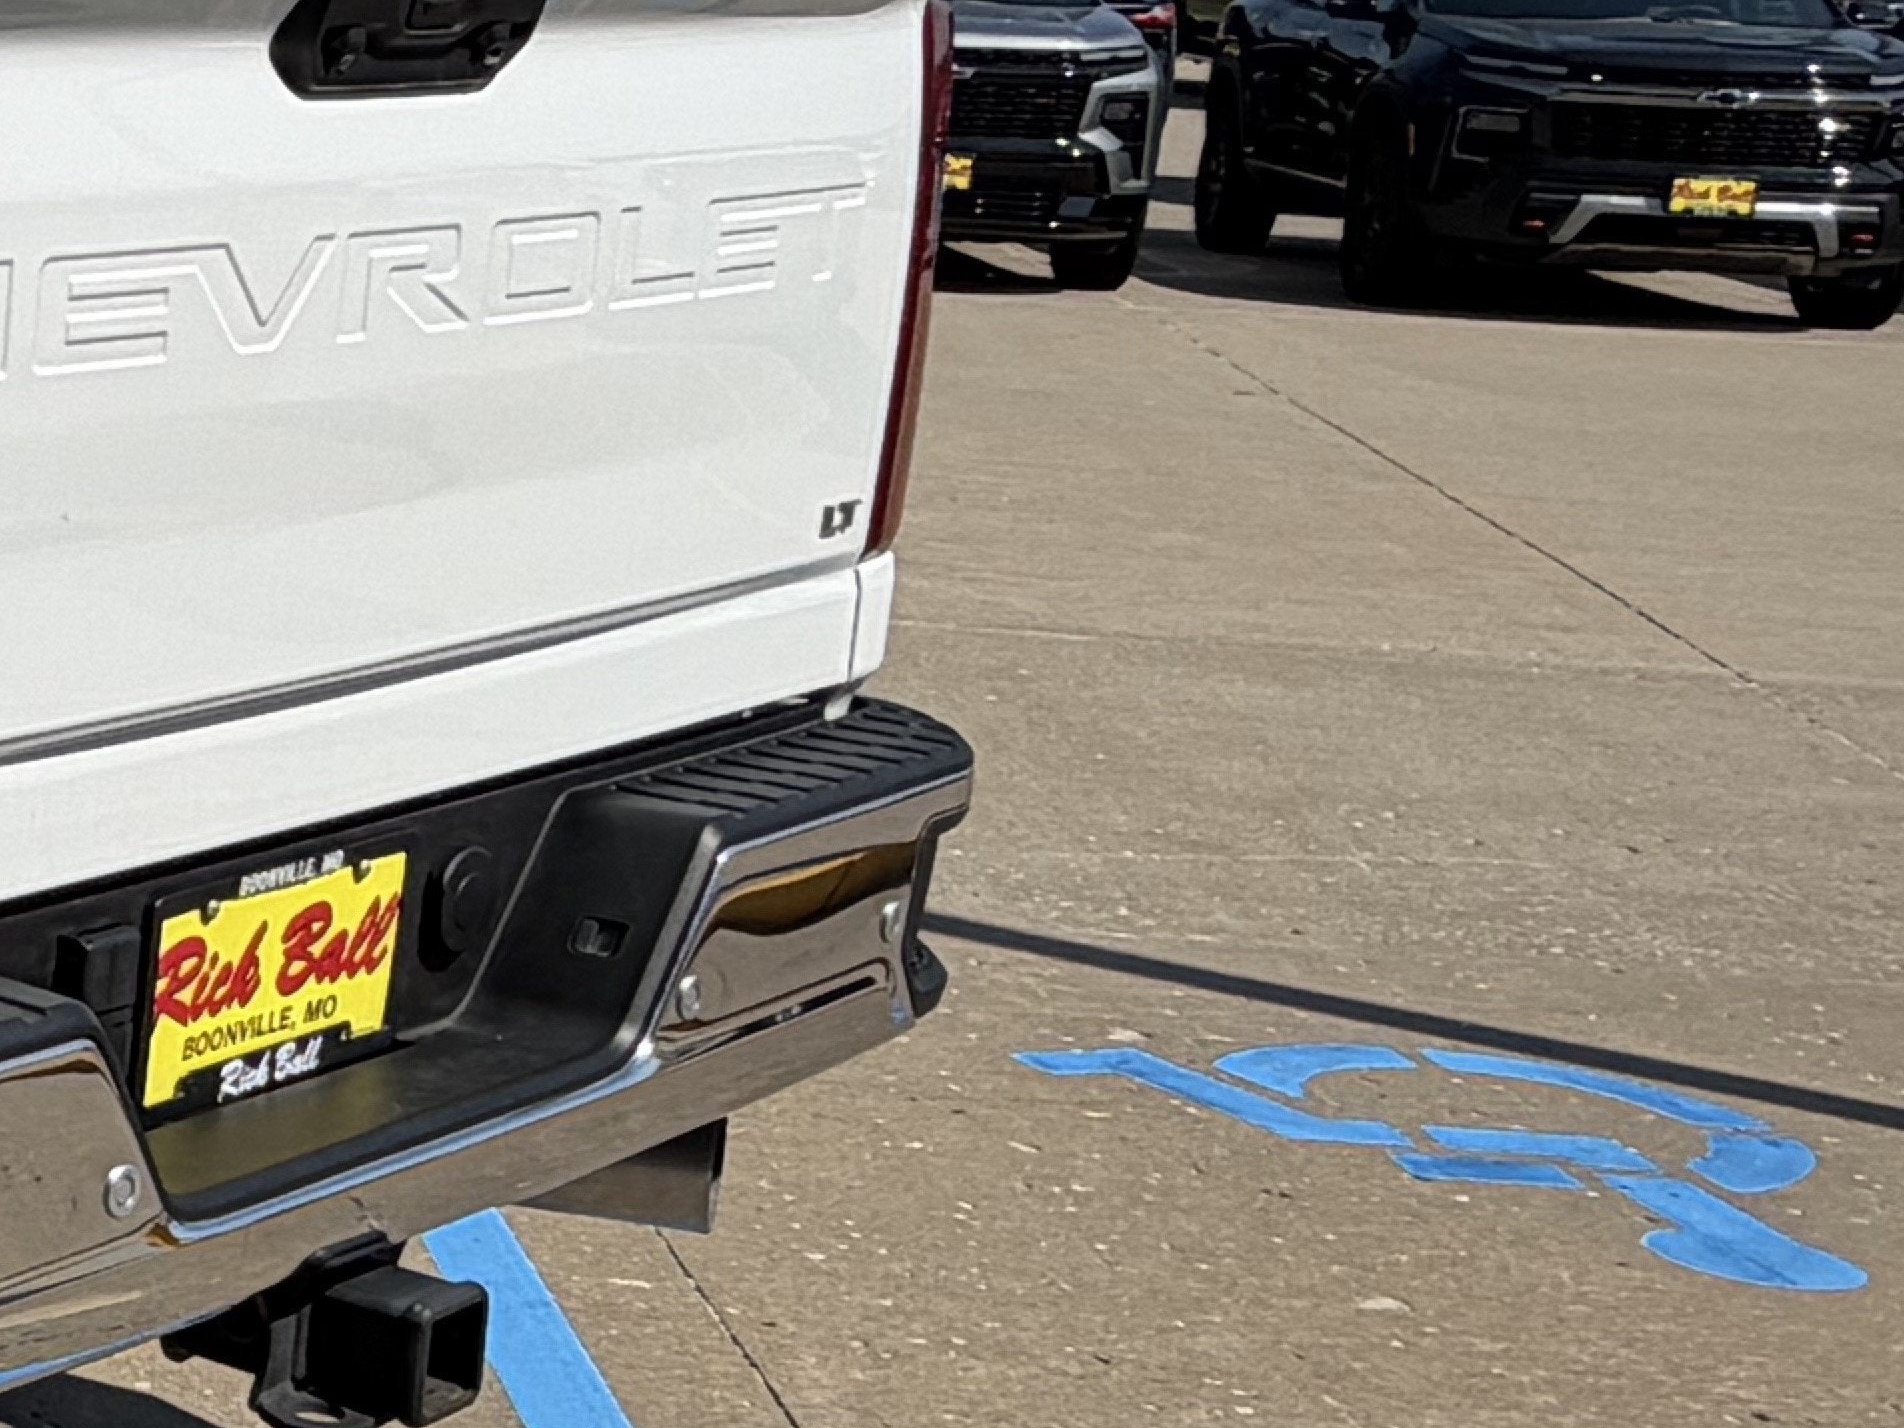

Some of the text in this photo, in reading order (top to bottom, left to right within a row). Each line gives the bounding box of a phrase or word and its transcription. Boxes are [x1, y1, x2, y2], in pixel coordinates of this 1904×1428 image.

[818, 498, 863, 539] LT
[153, 889, 404, 1028] Rick Ball
[181, 994, 338, 1062] BOONVILLE, MO
[216, 1035, 324, 1104] Rick Ball
